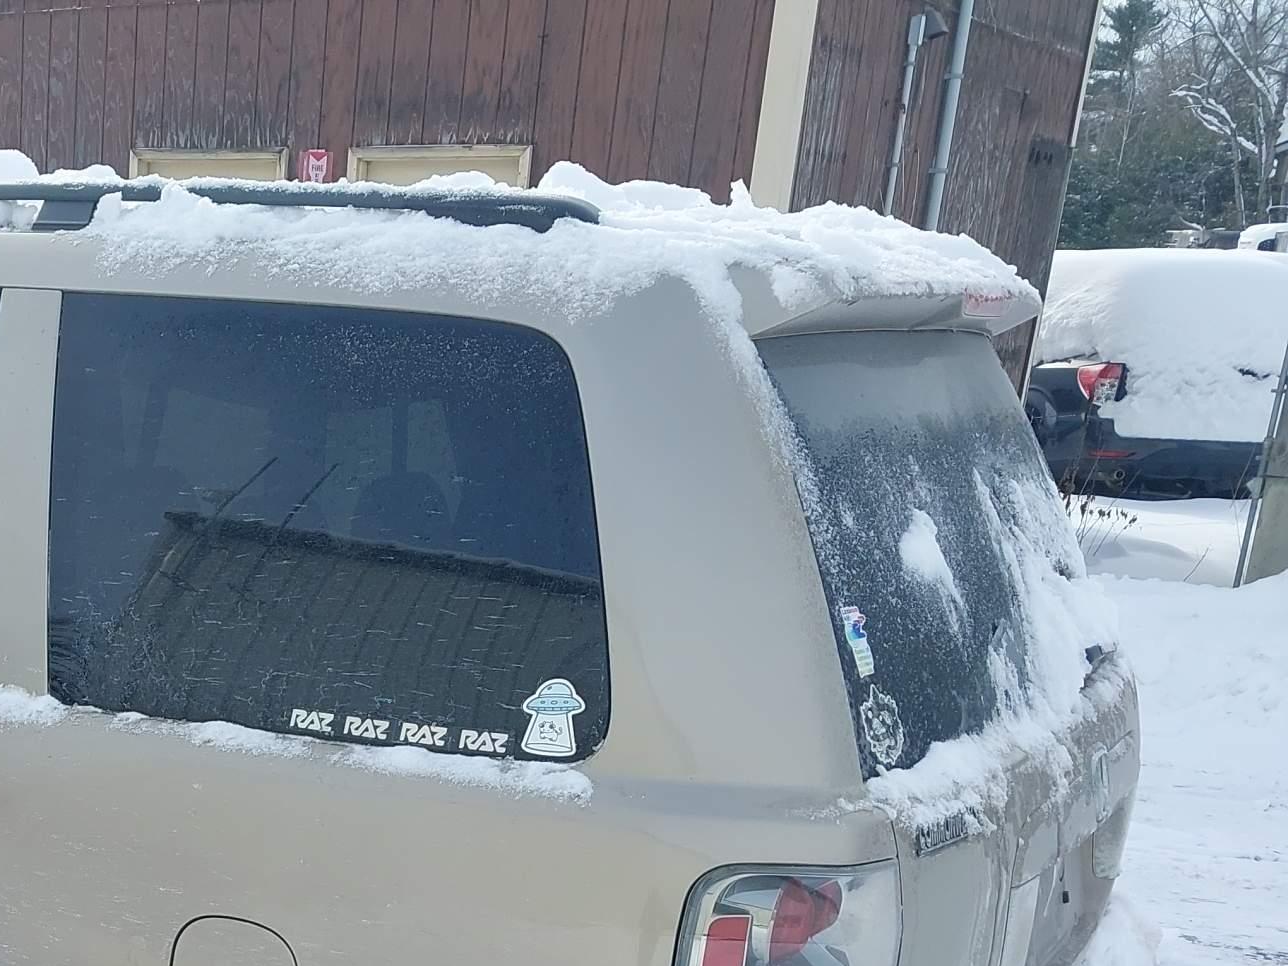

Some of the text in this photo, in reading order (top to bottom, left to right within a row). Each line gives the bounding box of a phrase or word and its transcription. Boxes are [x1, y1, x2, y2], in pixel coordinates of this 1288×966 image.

[312, 164, 324, 172] FIRE
[289, 708, 509, 754] RAZ RAZ RAZ RAZ
